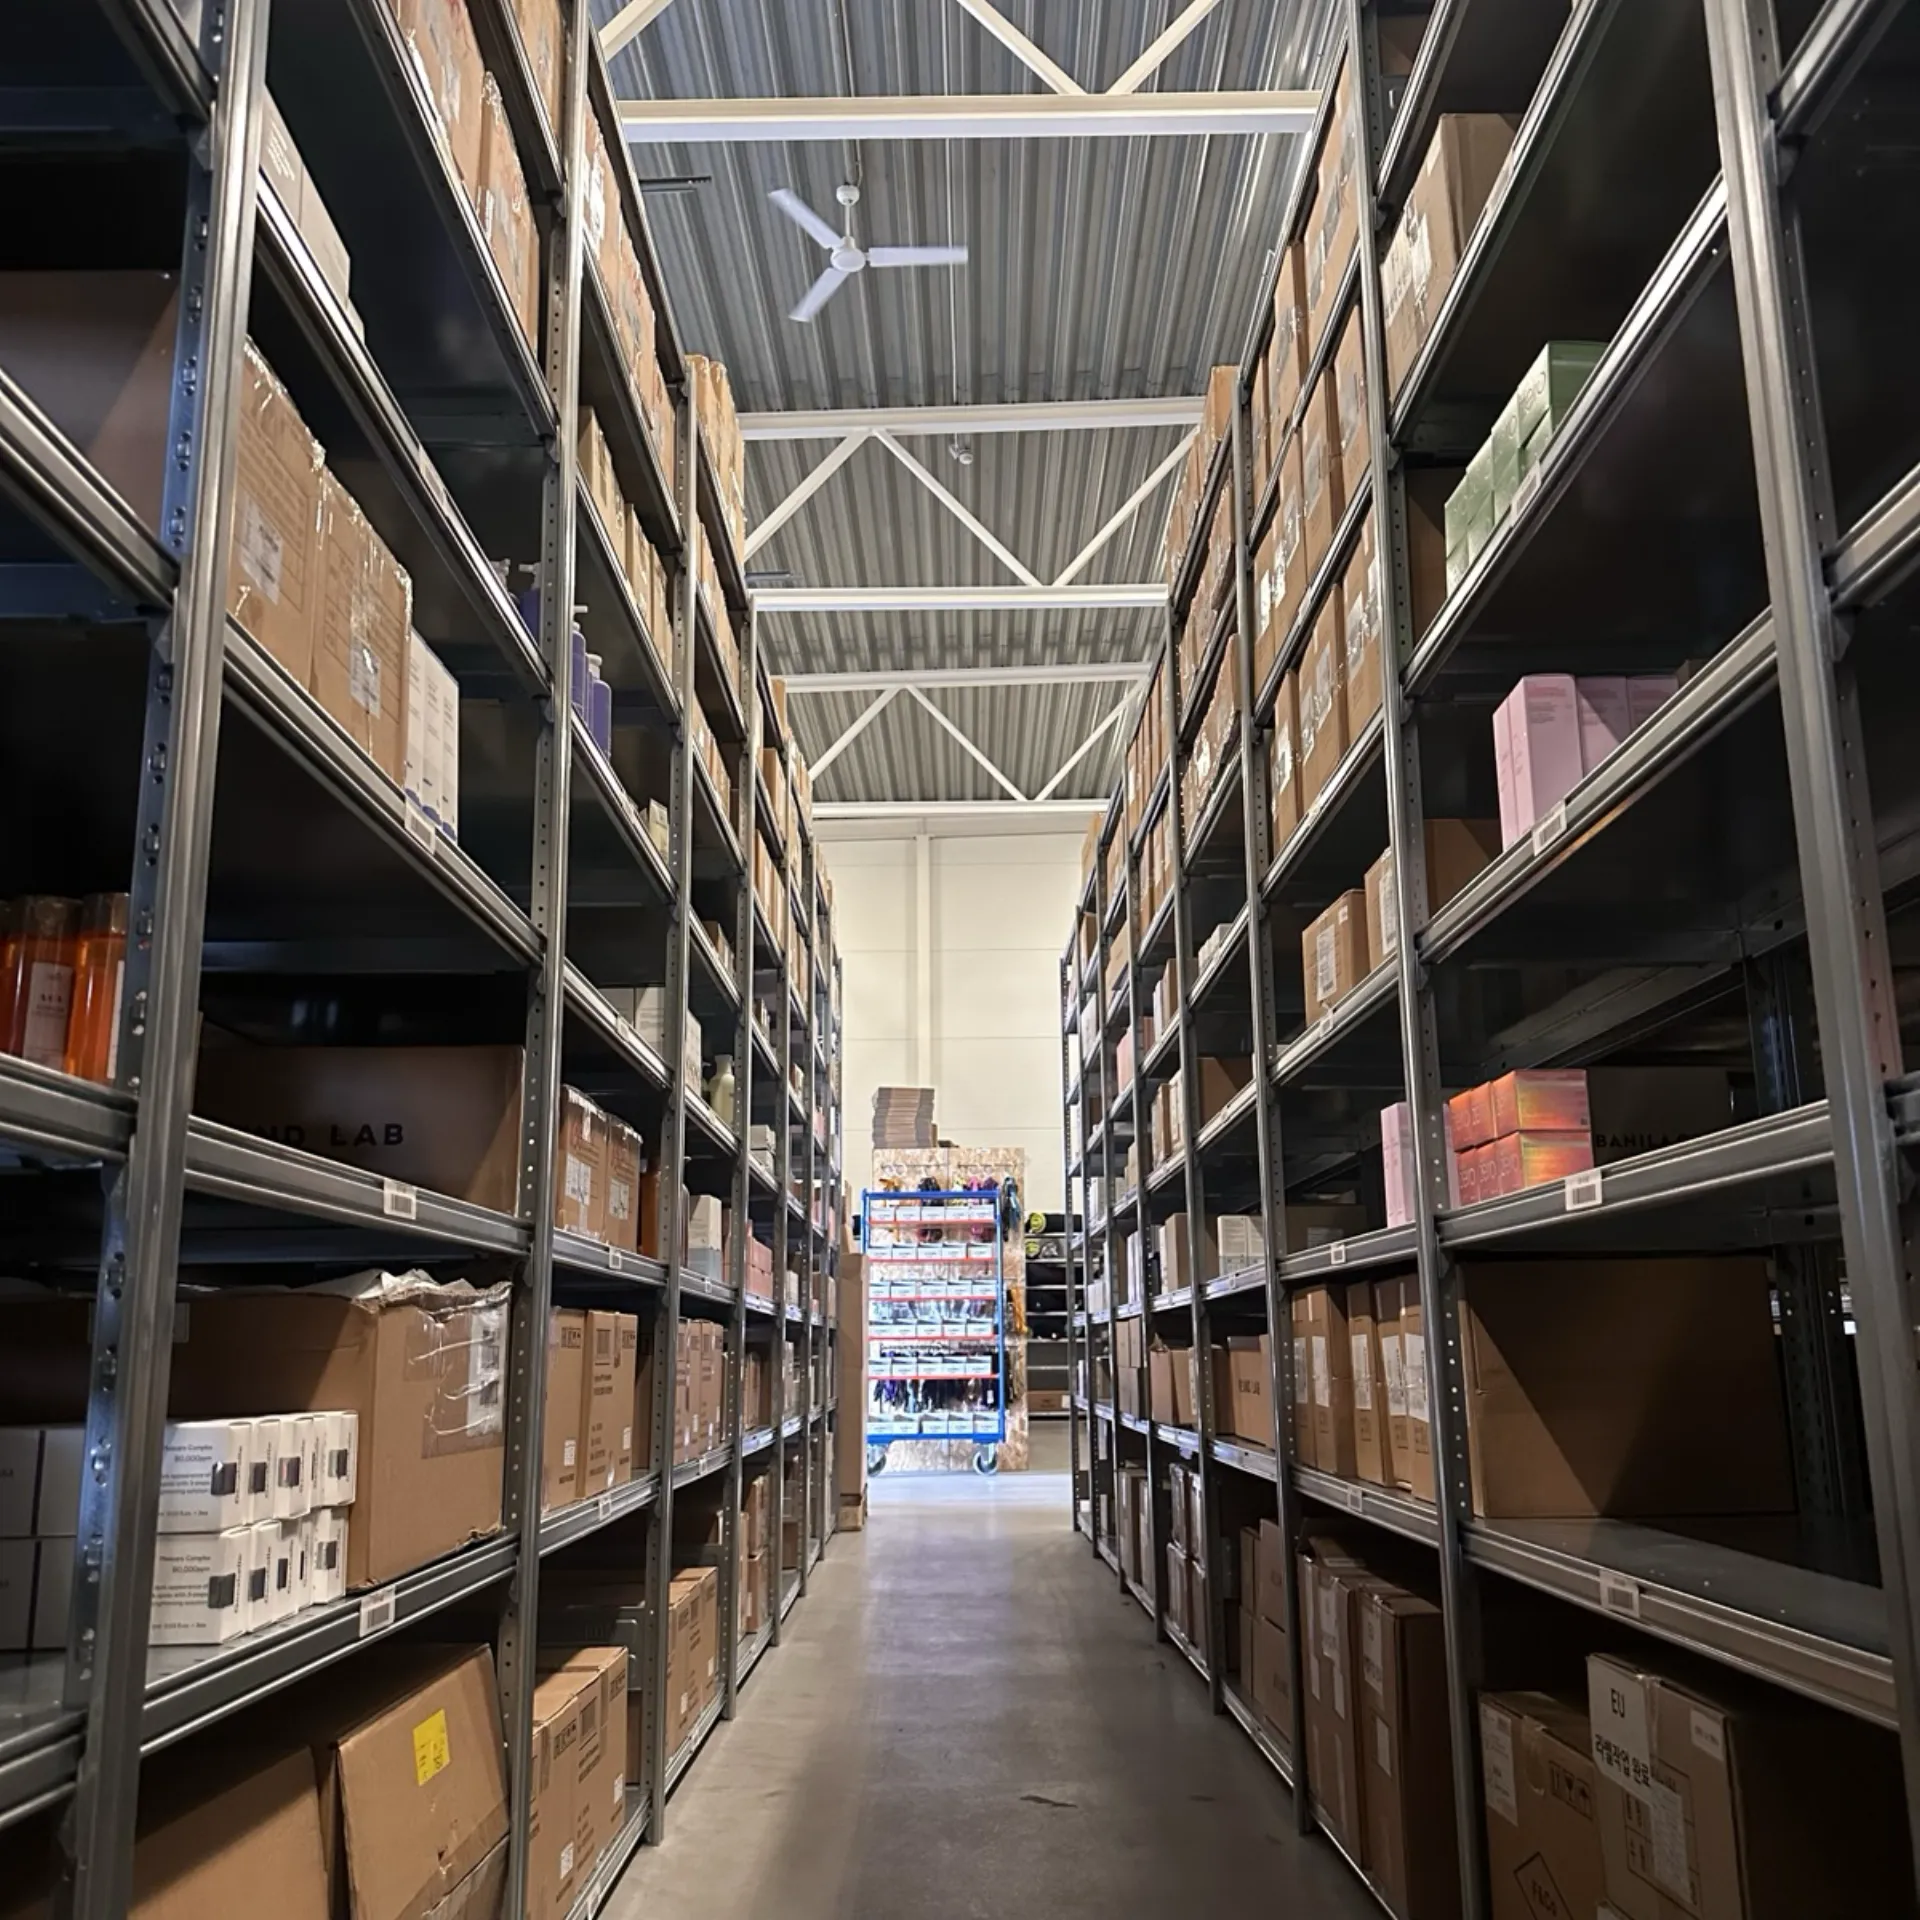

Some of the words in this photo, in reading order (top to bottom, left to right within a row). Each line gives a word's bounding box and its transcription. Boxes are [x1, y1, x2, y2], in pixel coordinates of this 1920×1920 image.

[330, 1123, 404, 1147] LAB
[1610, 1687, 1626, 1719] EU
[1594, 1733, 1631, 1778] 라벨작업
[1632, 1756, 1651, 1788] 완료
